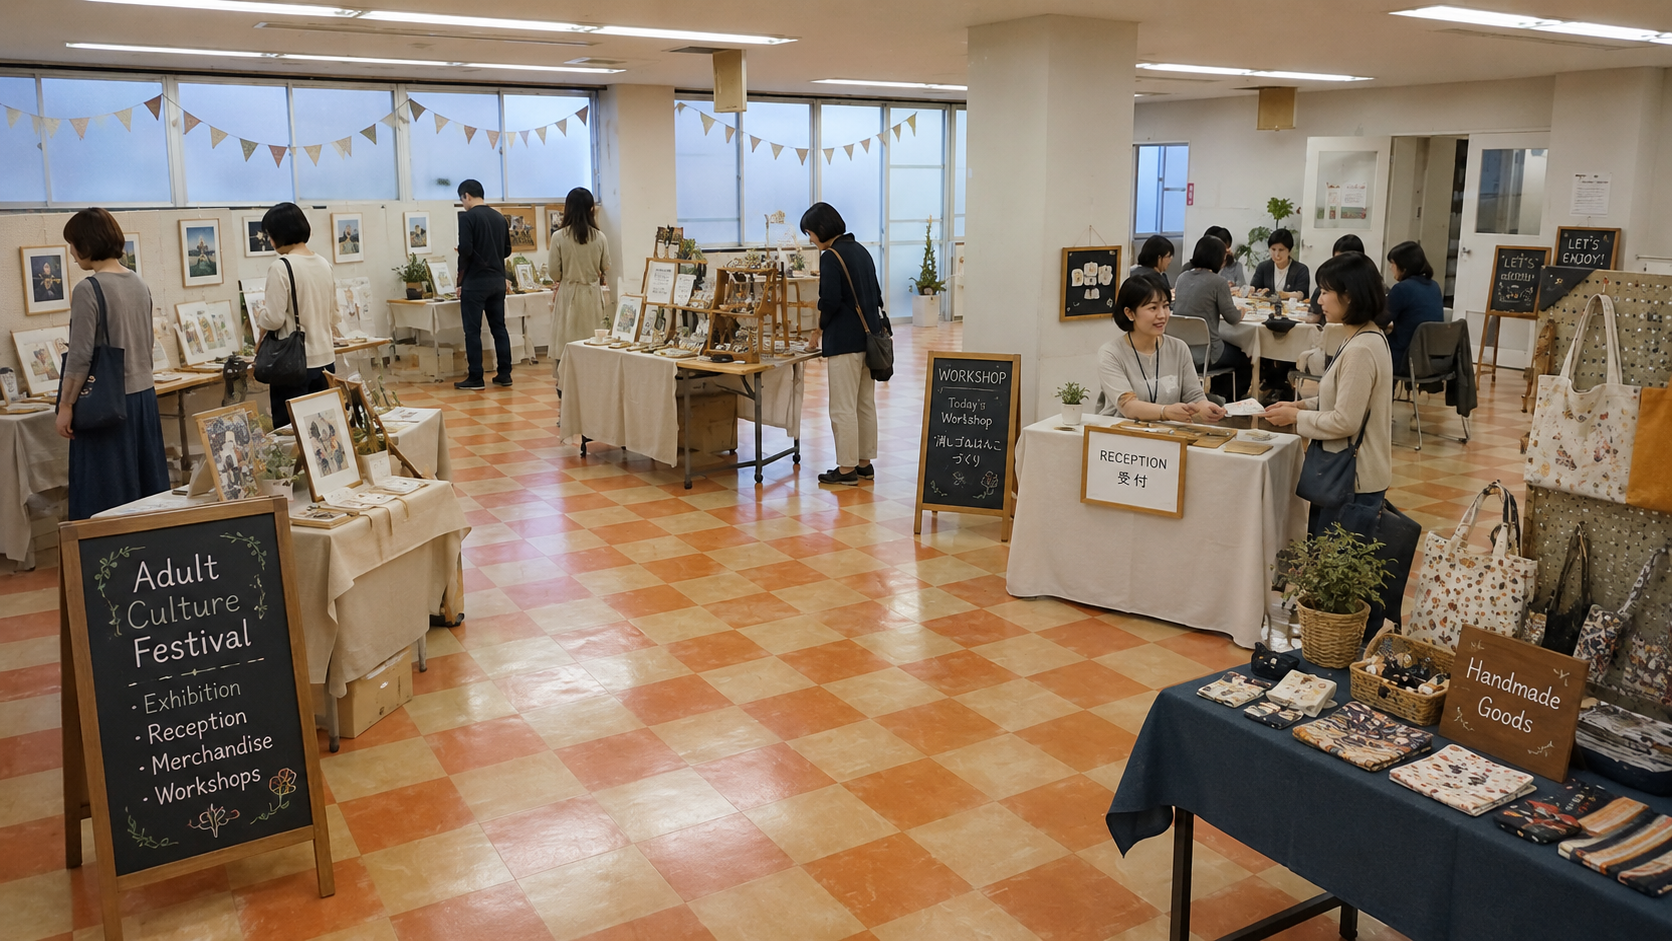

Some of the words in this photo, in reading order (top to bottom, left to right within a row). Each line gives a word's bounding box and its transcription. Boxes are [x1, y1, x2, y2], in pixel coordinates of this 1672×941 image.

[1562, 253, 1605, 266] ENJOY!
[1568, 236, 1600, 251] LET'S
[938, 367, 1007, 385] WORKSHOP
[948, 397, 986, 413] Today's
[952, 453, 980, 468] づくり
[1100, 449, 1168, 470] RECEPTION
[1117, 471, 1148, 489] 受付
[132, 553, 220, 594] Adult
[126, 594, 241, 631] Culture
[133, 618, 252, 669] Festival
[143, 681, 242, 716] Exhibition
[1466, 656, 1561, 711] Handmade
[147, 710, 248, 746] Reception
[1477, 696, 1534, 734] Goods
[151, 733, 274, 777] Merchandise
[154, 767, 262, 806] Workshops
